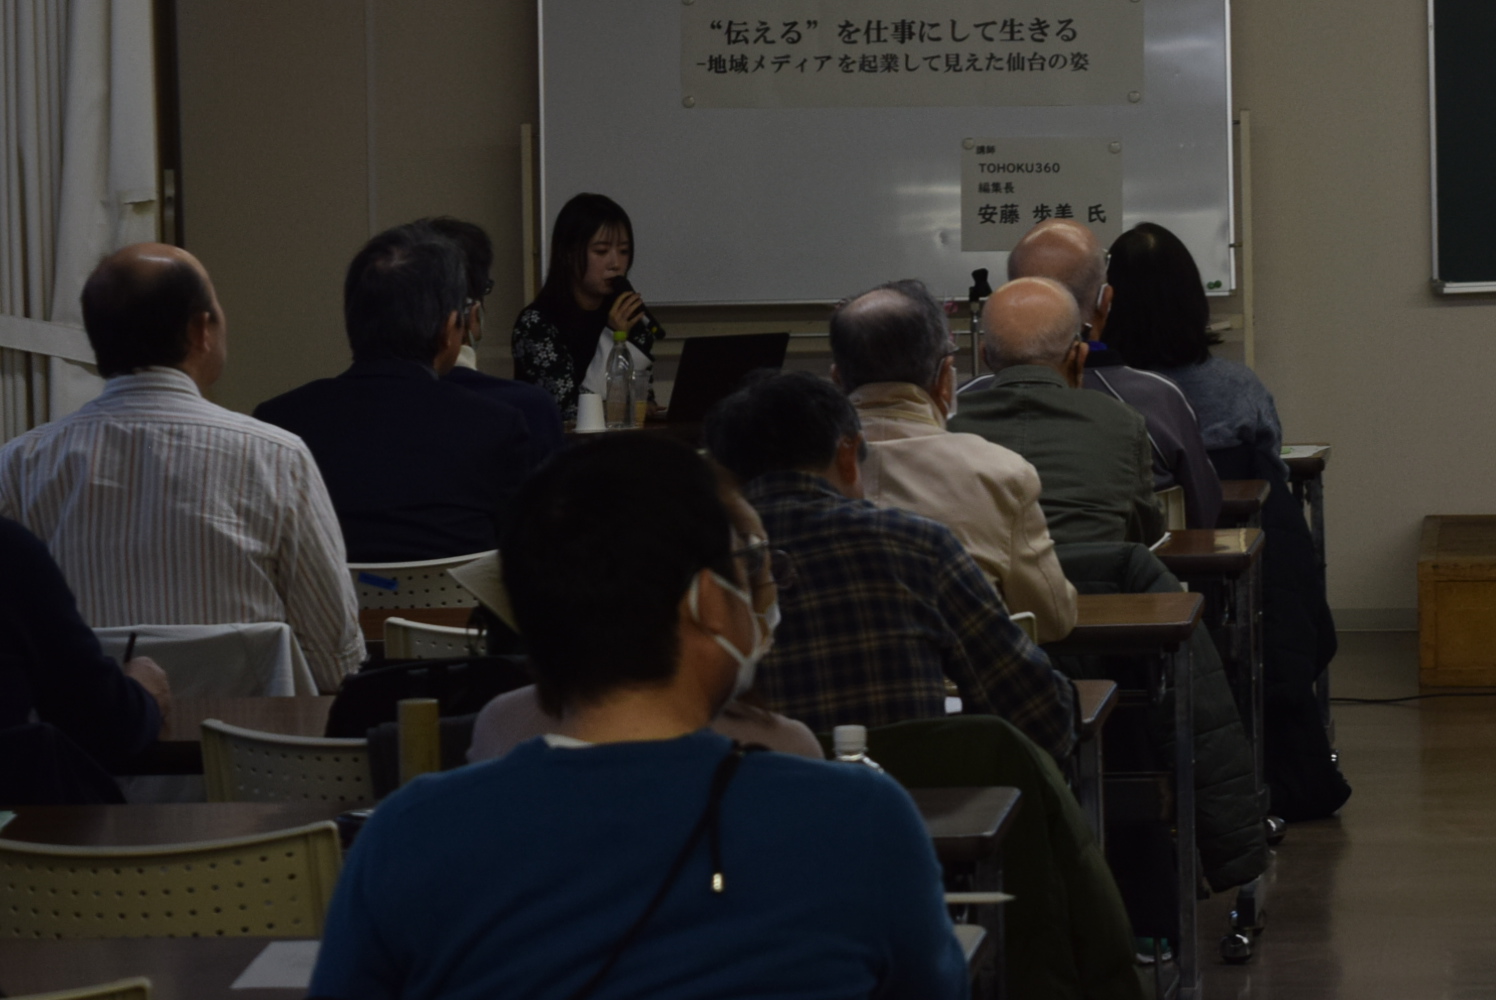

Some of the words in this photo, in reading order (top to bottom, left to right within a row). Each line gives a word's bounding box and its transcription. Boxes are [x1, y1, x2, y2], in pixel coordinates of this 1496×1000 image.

[978, 163, 1060, 173] TOHOKU360
[978, 182, 1014, 193] 編集長
[978, 204, 1020, 224] 安藤
[1088, 204, 1106, 223] 氏
